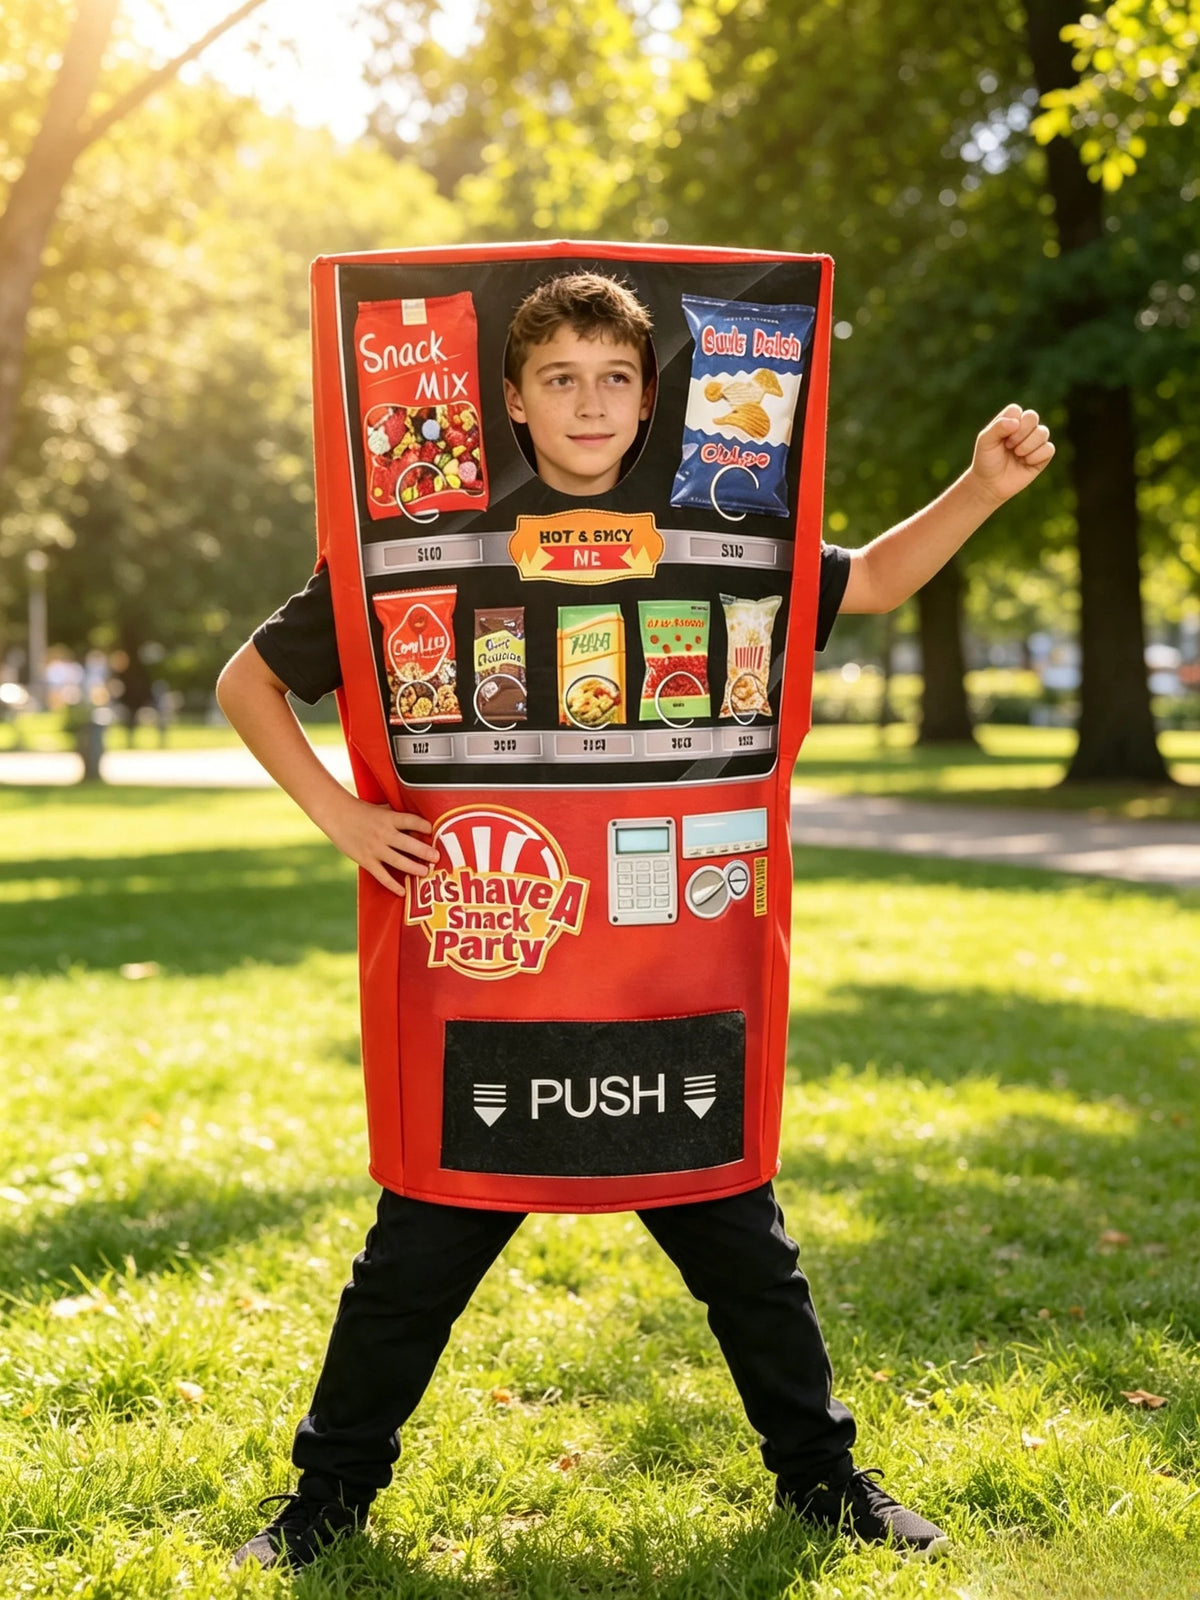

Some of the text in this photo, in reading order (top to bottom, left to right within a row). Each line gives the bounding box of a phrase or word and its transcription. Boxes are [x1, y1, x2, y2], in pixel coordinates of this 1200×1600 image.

[359, 329, 448, 374] Snack
[539, 530, 574, 544] HOT
[578, 530, 588, 543] &
[408, 871, 460, 920] Let's
[459, 871, 553, 909] have
[548, 880, 585, 928] A
[448, 904, 531, 933] Snack
[433, 930, 546, 969] Party
[530, 1073, 666, 1120] PUSH
